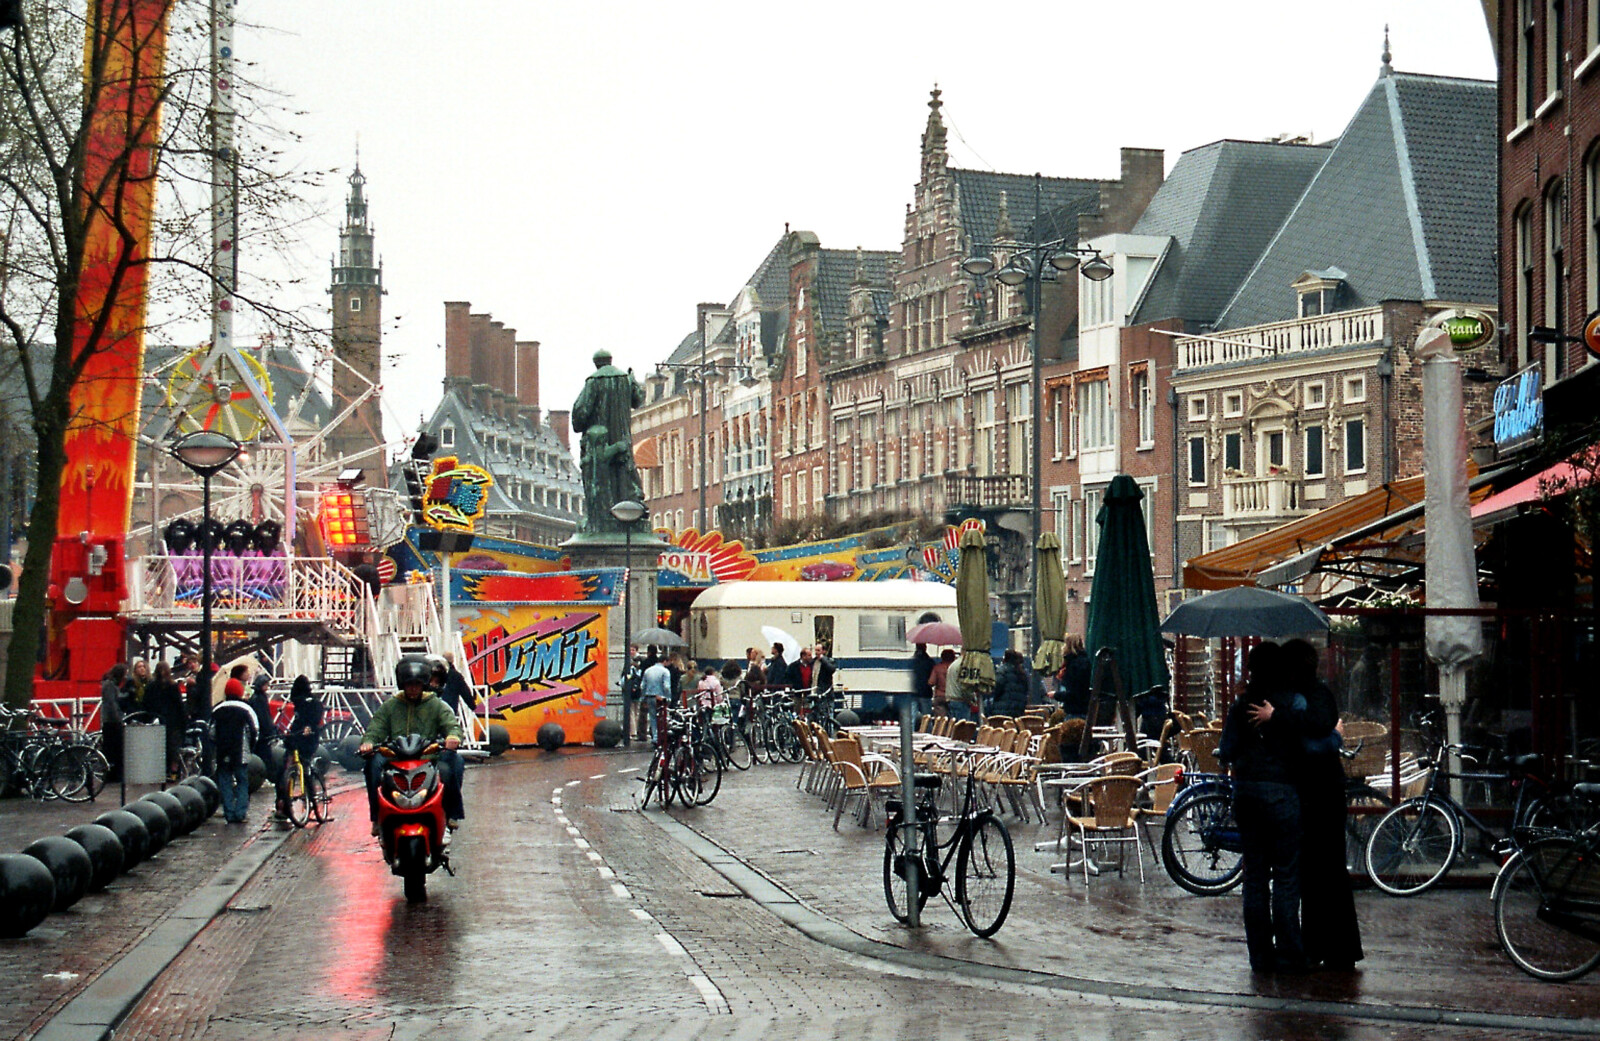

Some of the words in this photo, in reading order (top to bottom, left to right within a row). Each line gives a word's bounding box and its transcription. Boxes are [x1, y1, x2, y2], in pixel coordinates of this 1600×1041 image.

[1441, 321, 1483, 335] Brand
[657, 553, 710, 579] TONA
[464, 625, 507, 686] NO
